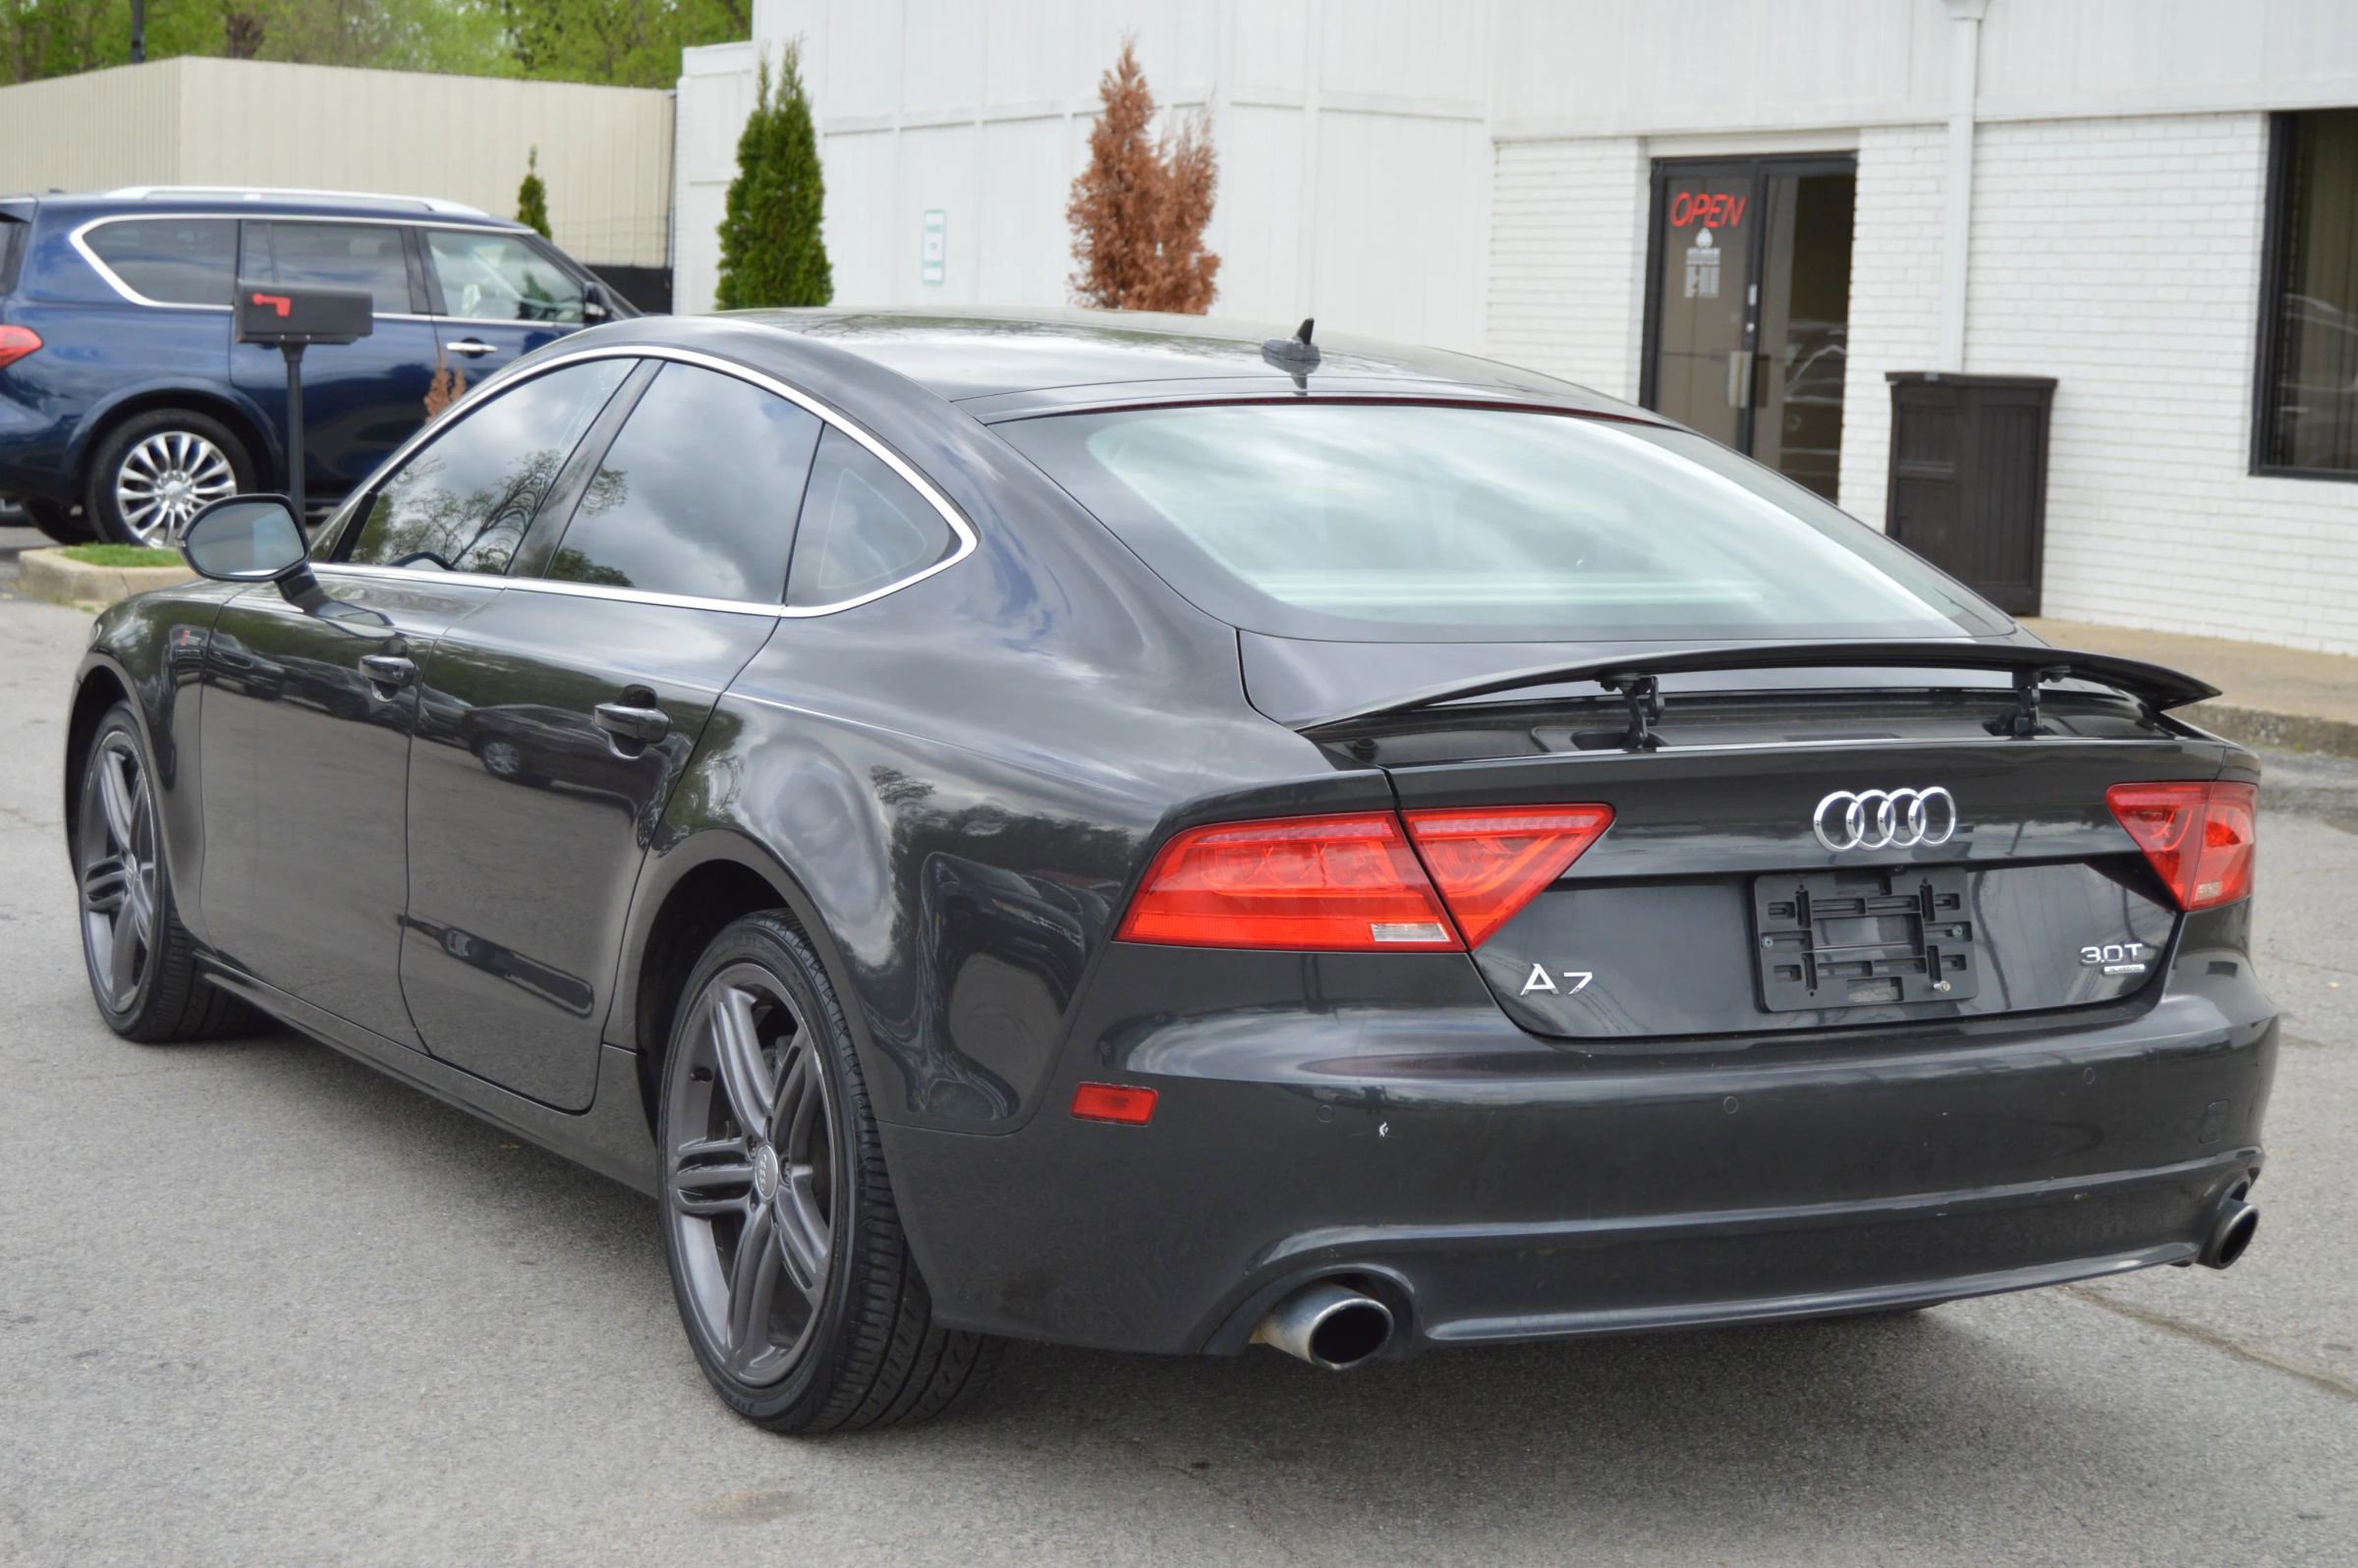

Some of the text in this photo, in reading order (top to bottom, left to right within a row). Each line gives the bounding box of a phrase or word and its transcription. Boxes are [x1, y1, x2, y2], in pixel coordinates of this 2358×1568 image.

[1671, 192, 1746, 228] OPEN
[2080, 943, 2143, 964] 3.0T
[1519, 963, 1593, 996] A7
